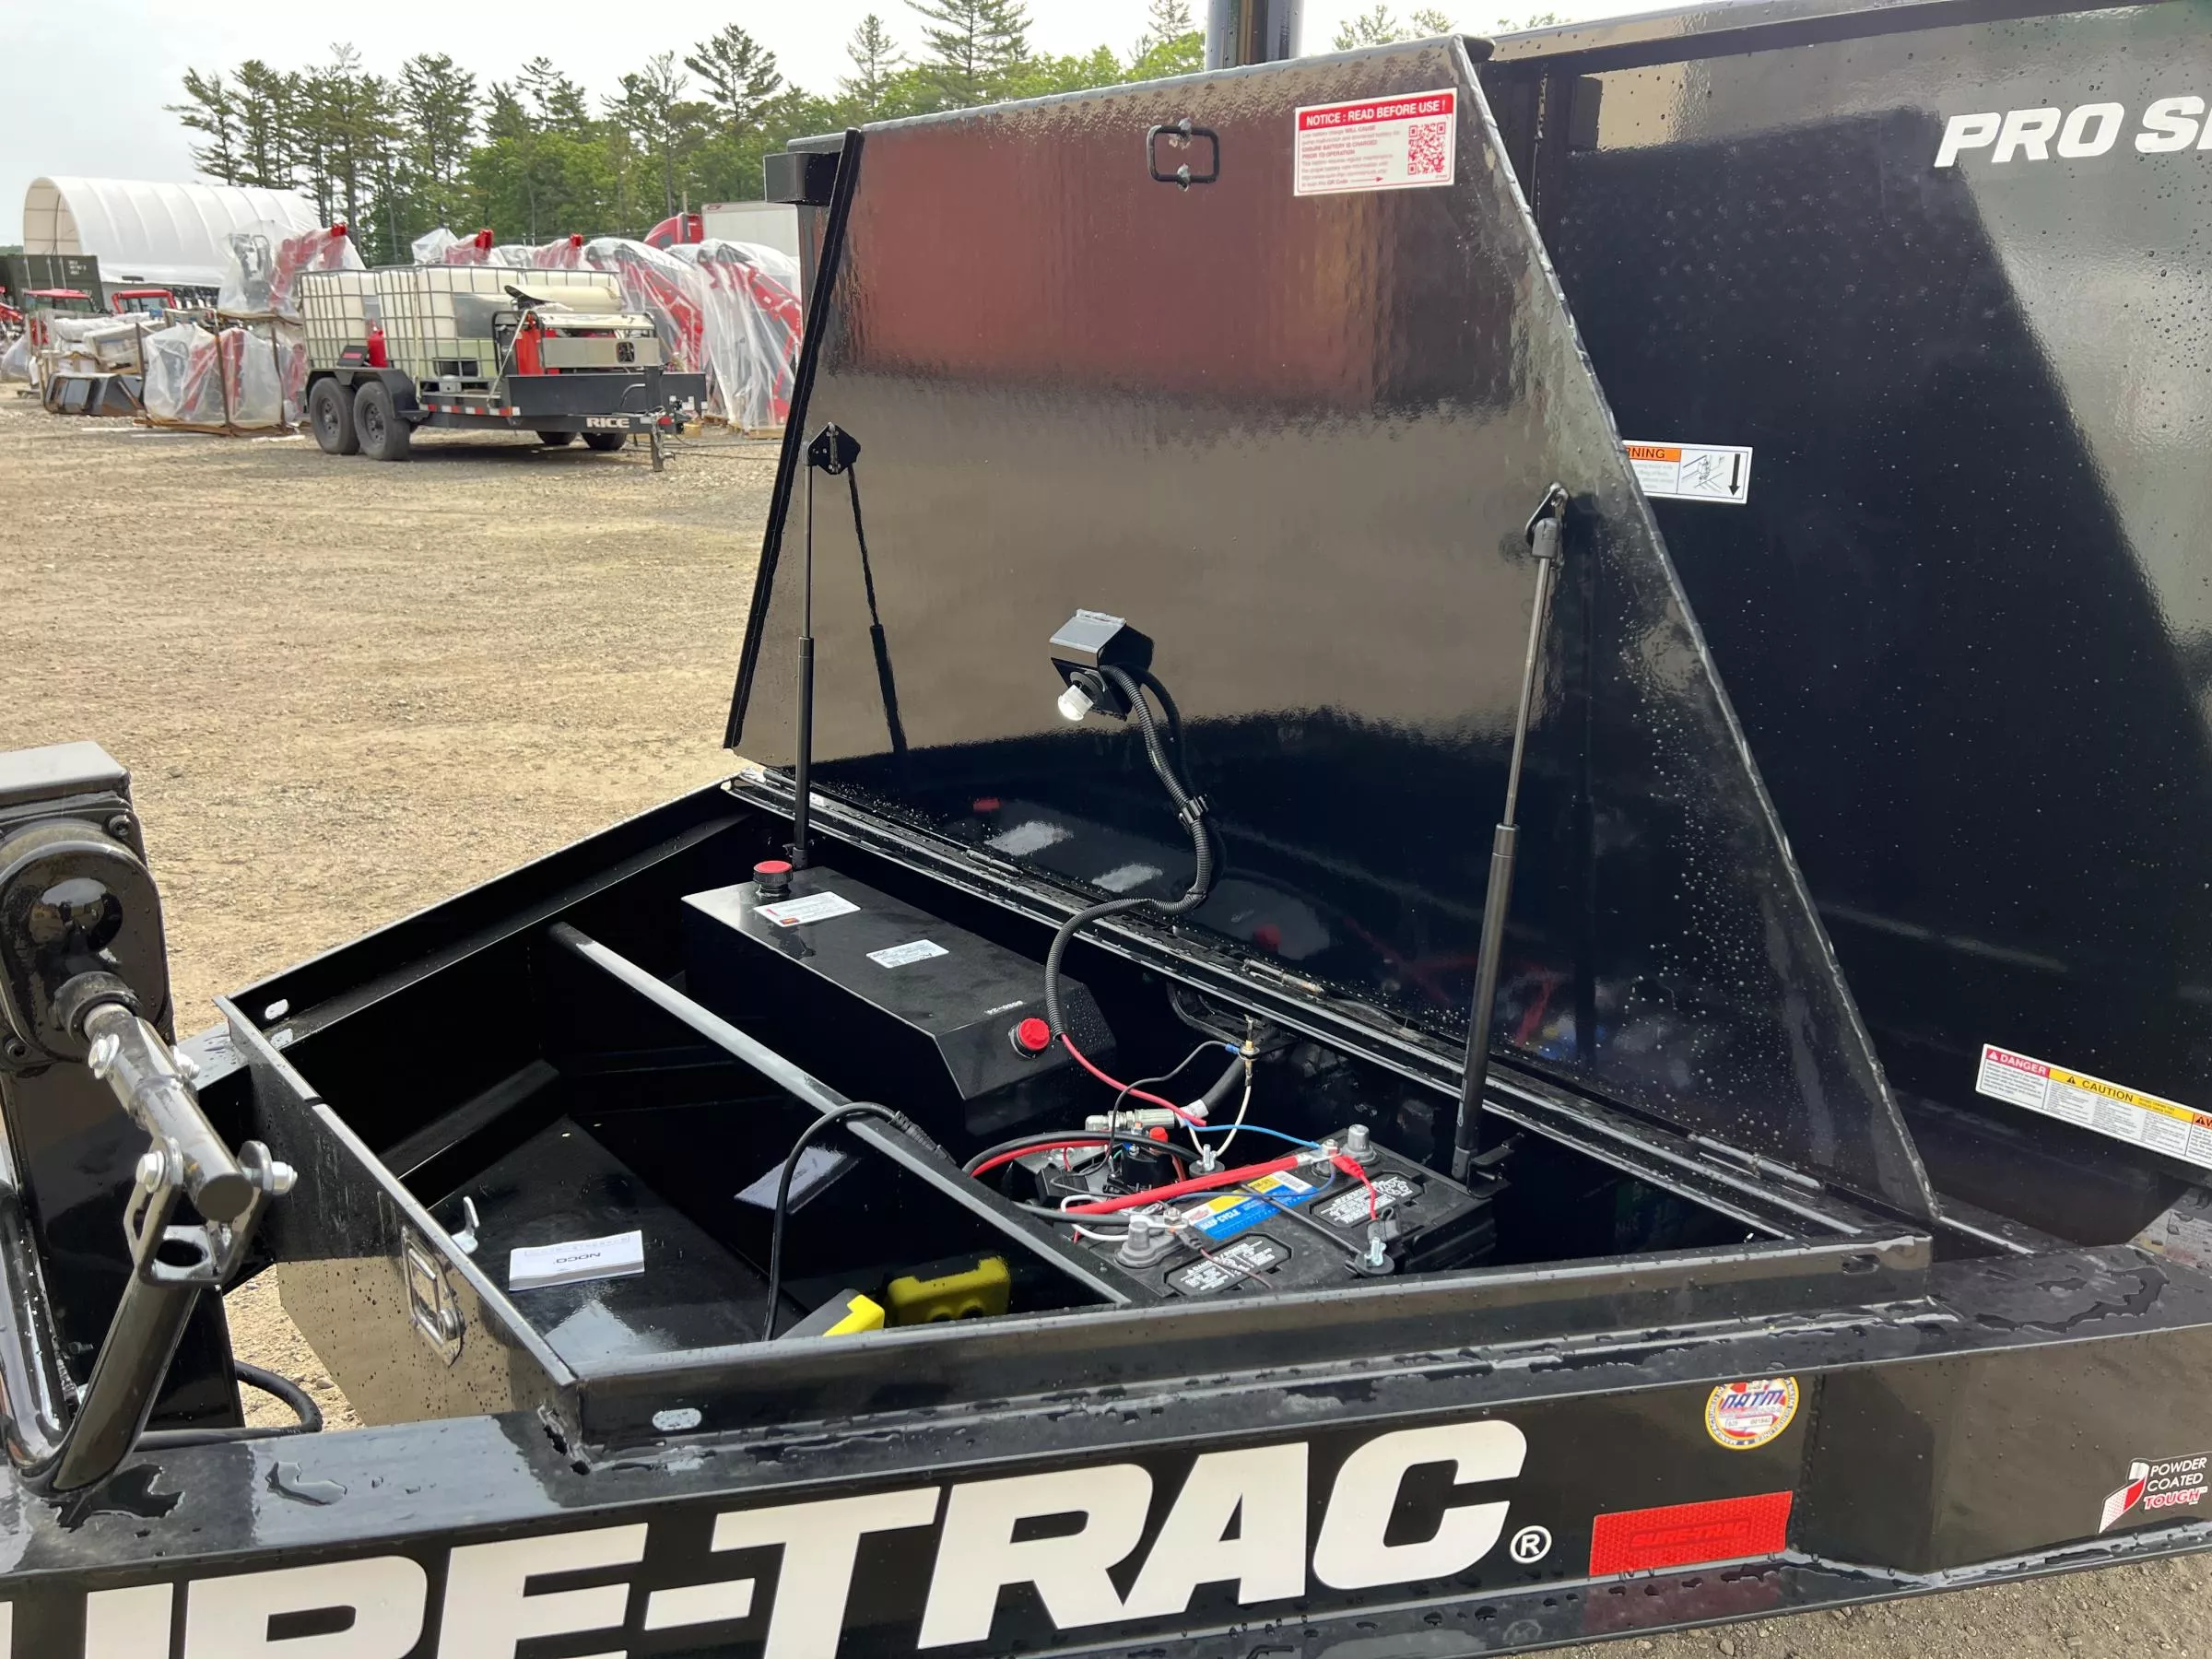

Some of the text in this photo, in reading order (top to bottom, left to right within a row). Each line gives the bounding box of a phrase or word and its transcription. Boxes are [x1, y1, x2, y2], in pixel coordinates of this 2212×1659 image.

[1306, 112, 1340, 127] NOTICE
[1347, 109, 1375, 121] READ
[1376, 104, 1416, 117] BEFORE
[1418, 100, 1440, 113] USE
[1934, 96, 2212, 168] PRO S
[586, 418, 629, 429] RICE
[2000, 1053, 2047, 1077] DANGER
[2081, 1079, 2134, 1103] CAUTION
[556, 1252, 601, 1264] NOCO
[2150, 1457, 2206, 1477] POWDER
[2147, 1473, 2203, 1491] COATED
[2144, 1487, 2203, 1510] TOUGH
